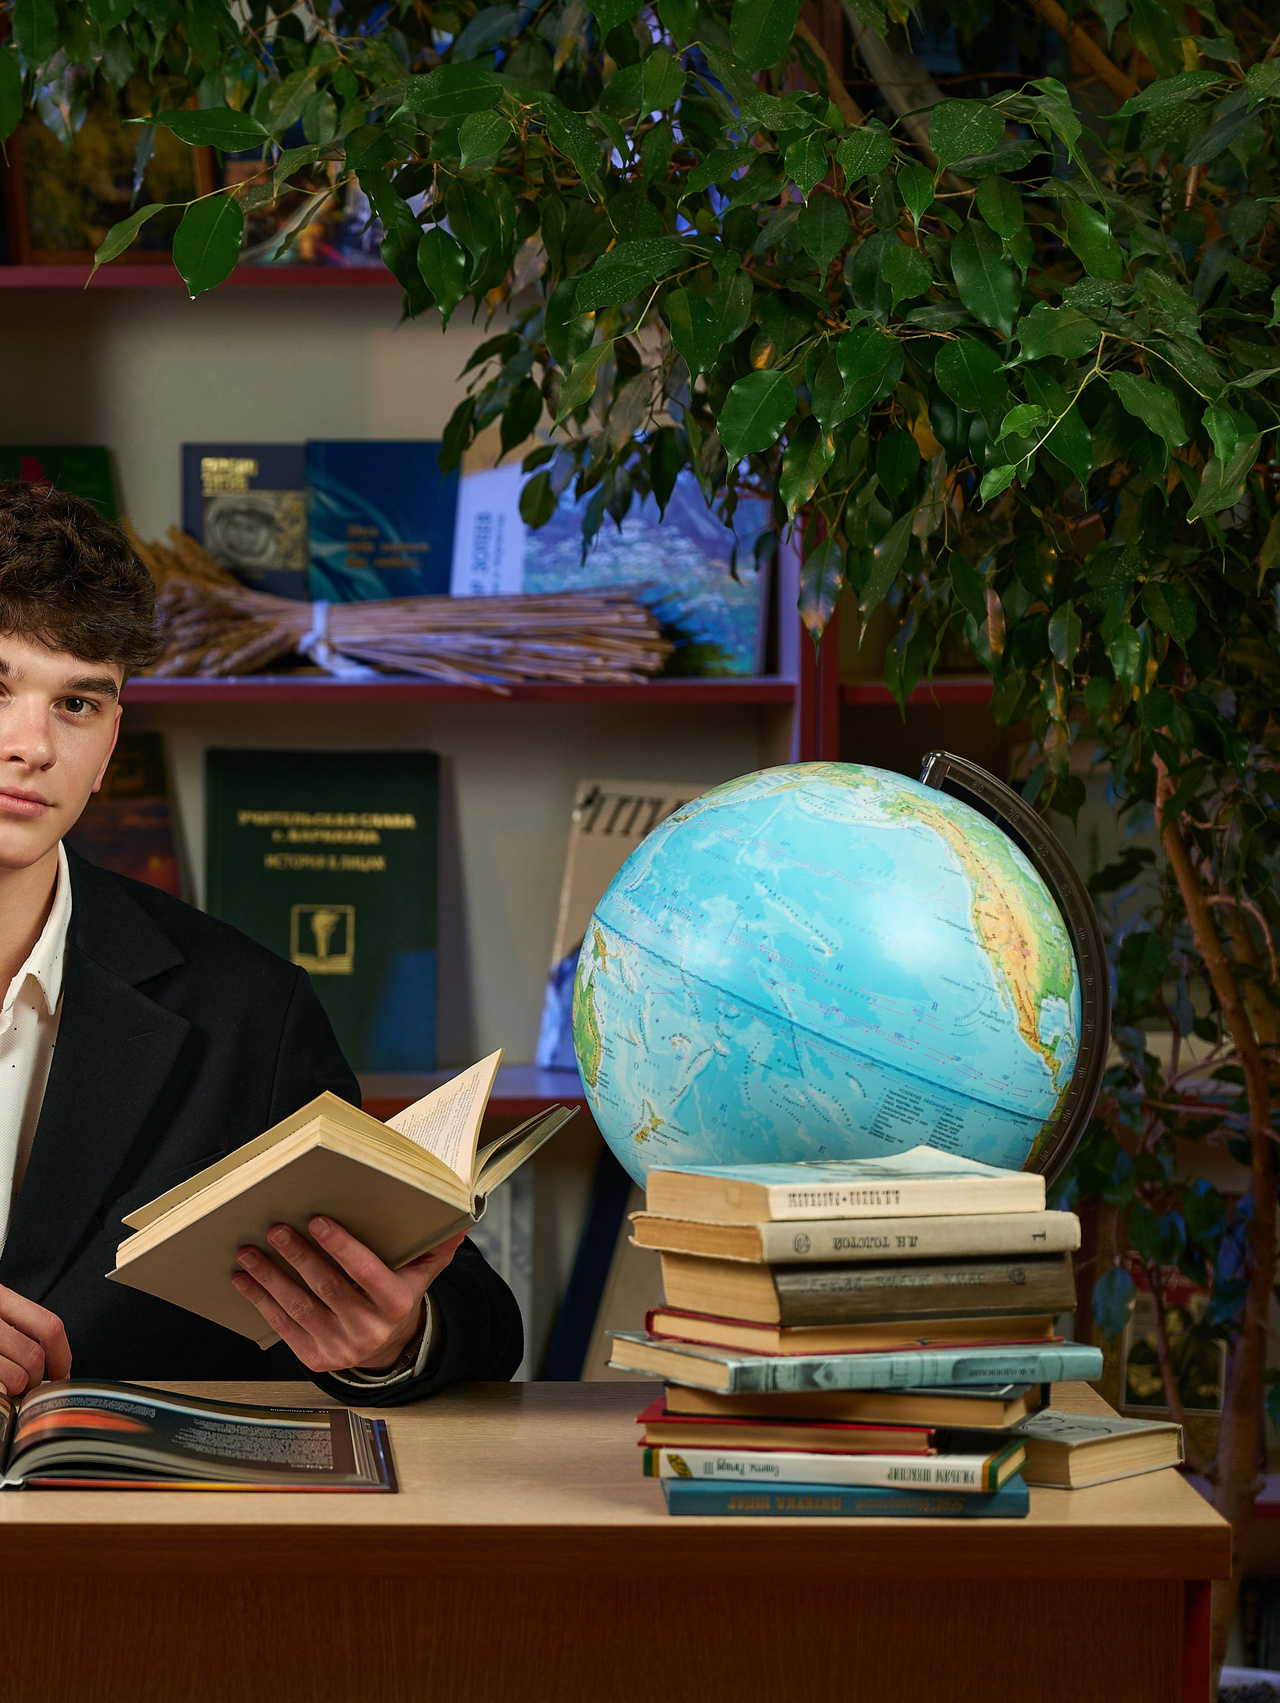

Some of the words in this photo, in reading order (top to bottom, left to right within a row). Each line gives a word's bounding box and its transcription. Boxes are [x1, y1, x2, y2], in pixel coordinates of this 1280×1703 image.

[832, 1235, 890, 1251] ТОЛСТОЙ
[885, 1467, 932, 1483] ШЕКСПИР
[936, 1468, 977, 1484] УИЛЬЯМ
